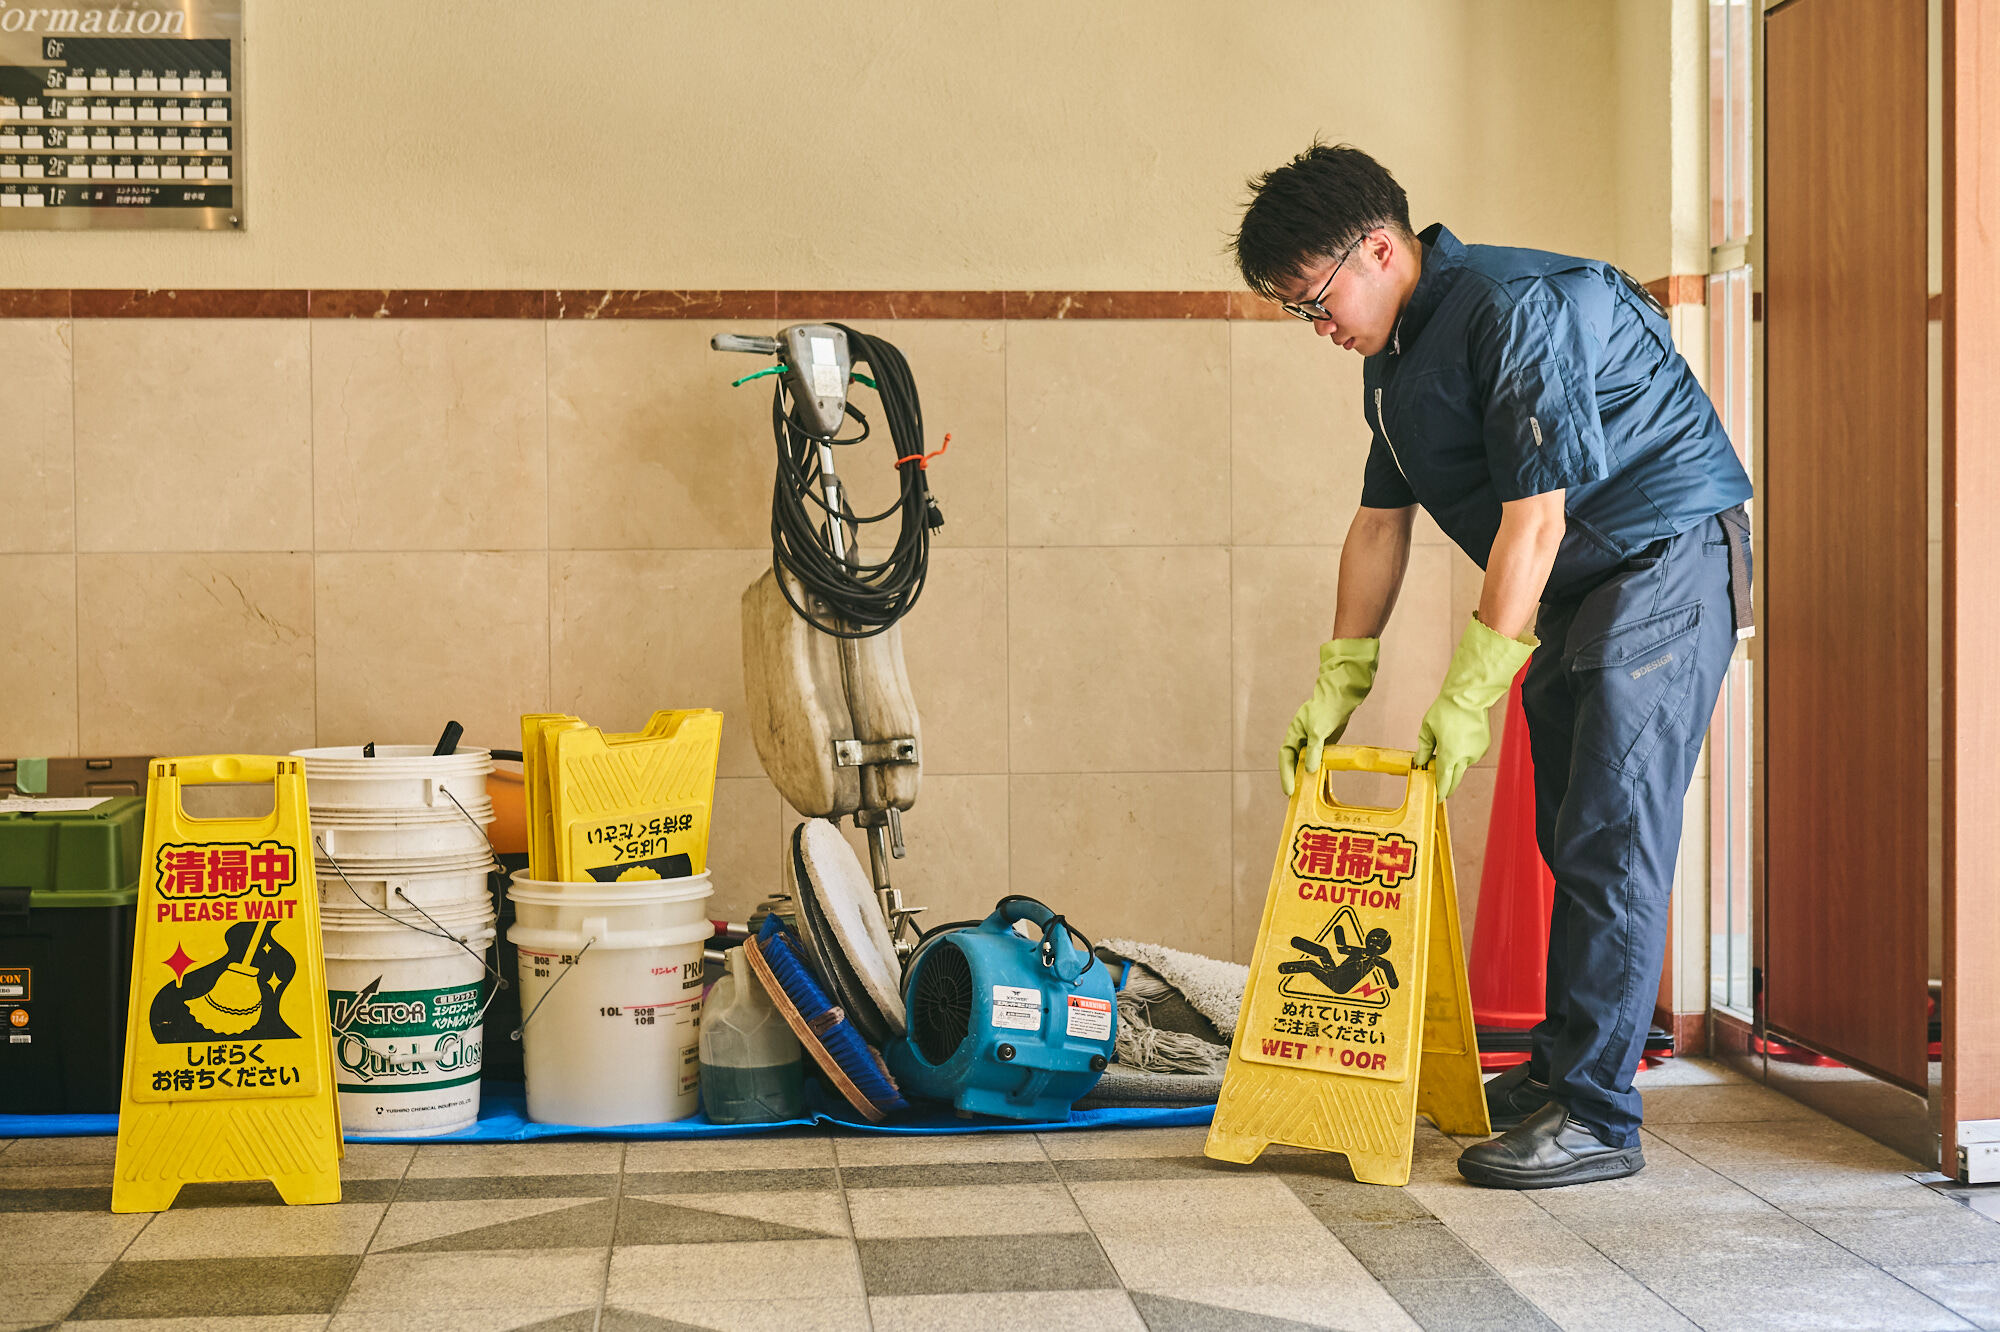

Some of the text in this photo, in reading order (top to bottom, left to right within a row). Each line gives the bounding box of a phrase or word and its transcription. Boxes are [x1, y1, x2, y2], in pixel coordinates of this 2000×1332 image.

[0, 0, 185, 33] ormation
[47, 39, 64, 58] 6F
[47, 68, 65, 88] 5F
[47, 98, 66, 117] 4F
[47, 127, 66, 146] 3F
[48, 156, 66, 176] 2F
[49, 187, 66, 205] 1F
[587, 814, 692, 844] お待ちください
[612, 837, 667, 861] しばらく
[1298, 832, 1412, 882] 清掃中
[164, 849, 289, 893] 清掃中
[1298, 882, 1401, 910] CAUTION
[157, 900, 297, 922] PLEASE WAIT
[334, 980, 426, 1032] VECTOR
[432, 1000, 477, 1017] ユシロンコート
[600, 1007, 623, 1016] 10L
[1281, 1002, 1382, 1026] ぬれています
[1273, 1018, 1385, 1044] ご注意ください
[187, 1044, 265, 1067] しばらく
[337, 1031, 429, 1082] Quick
[1262, 1038, 1308, 1060] WET
[152, 1066, 300, 1091] お待ちください
